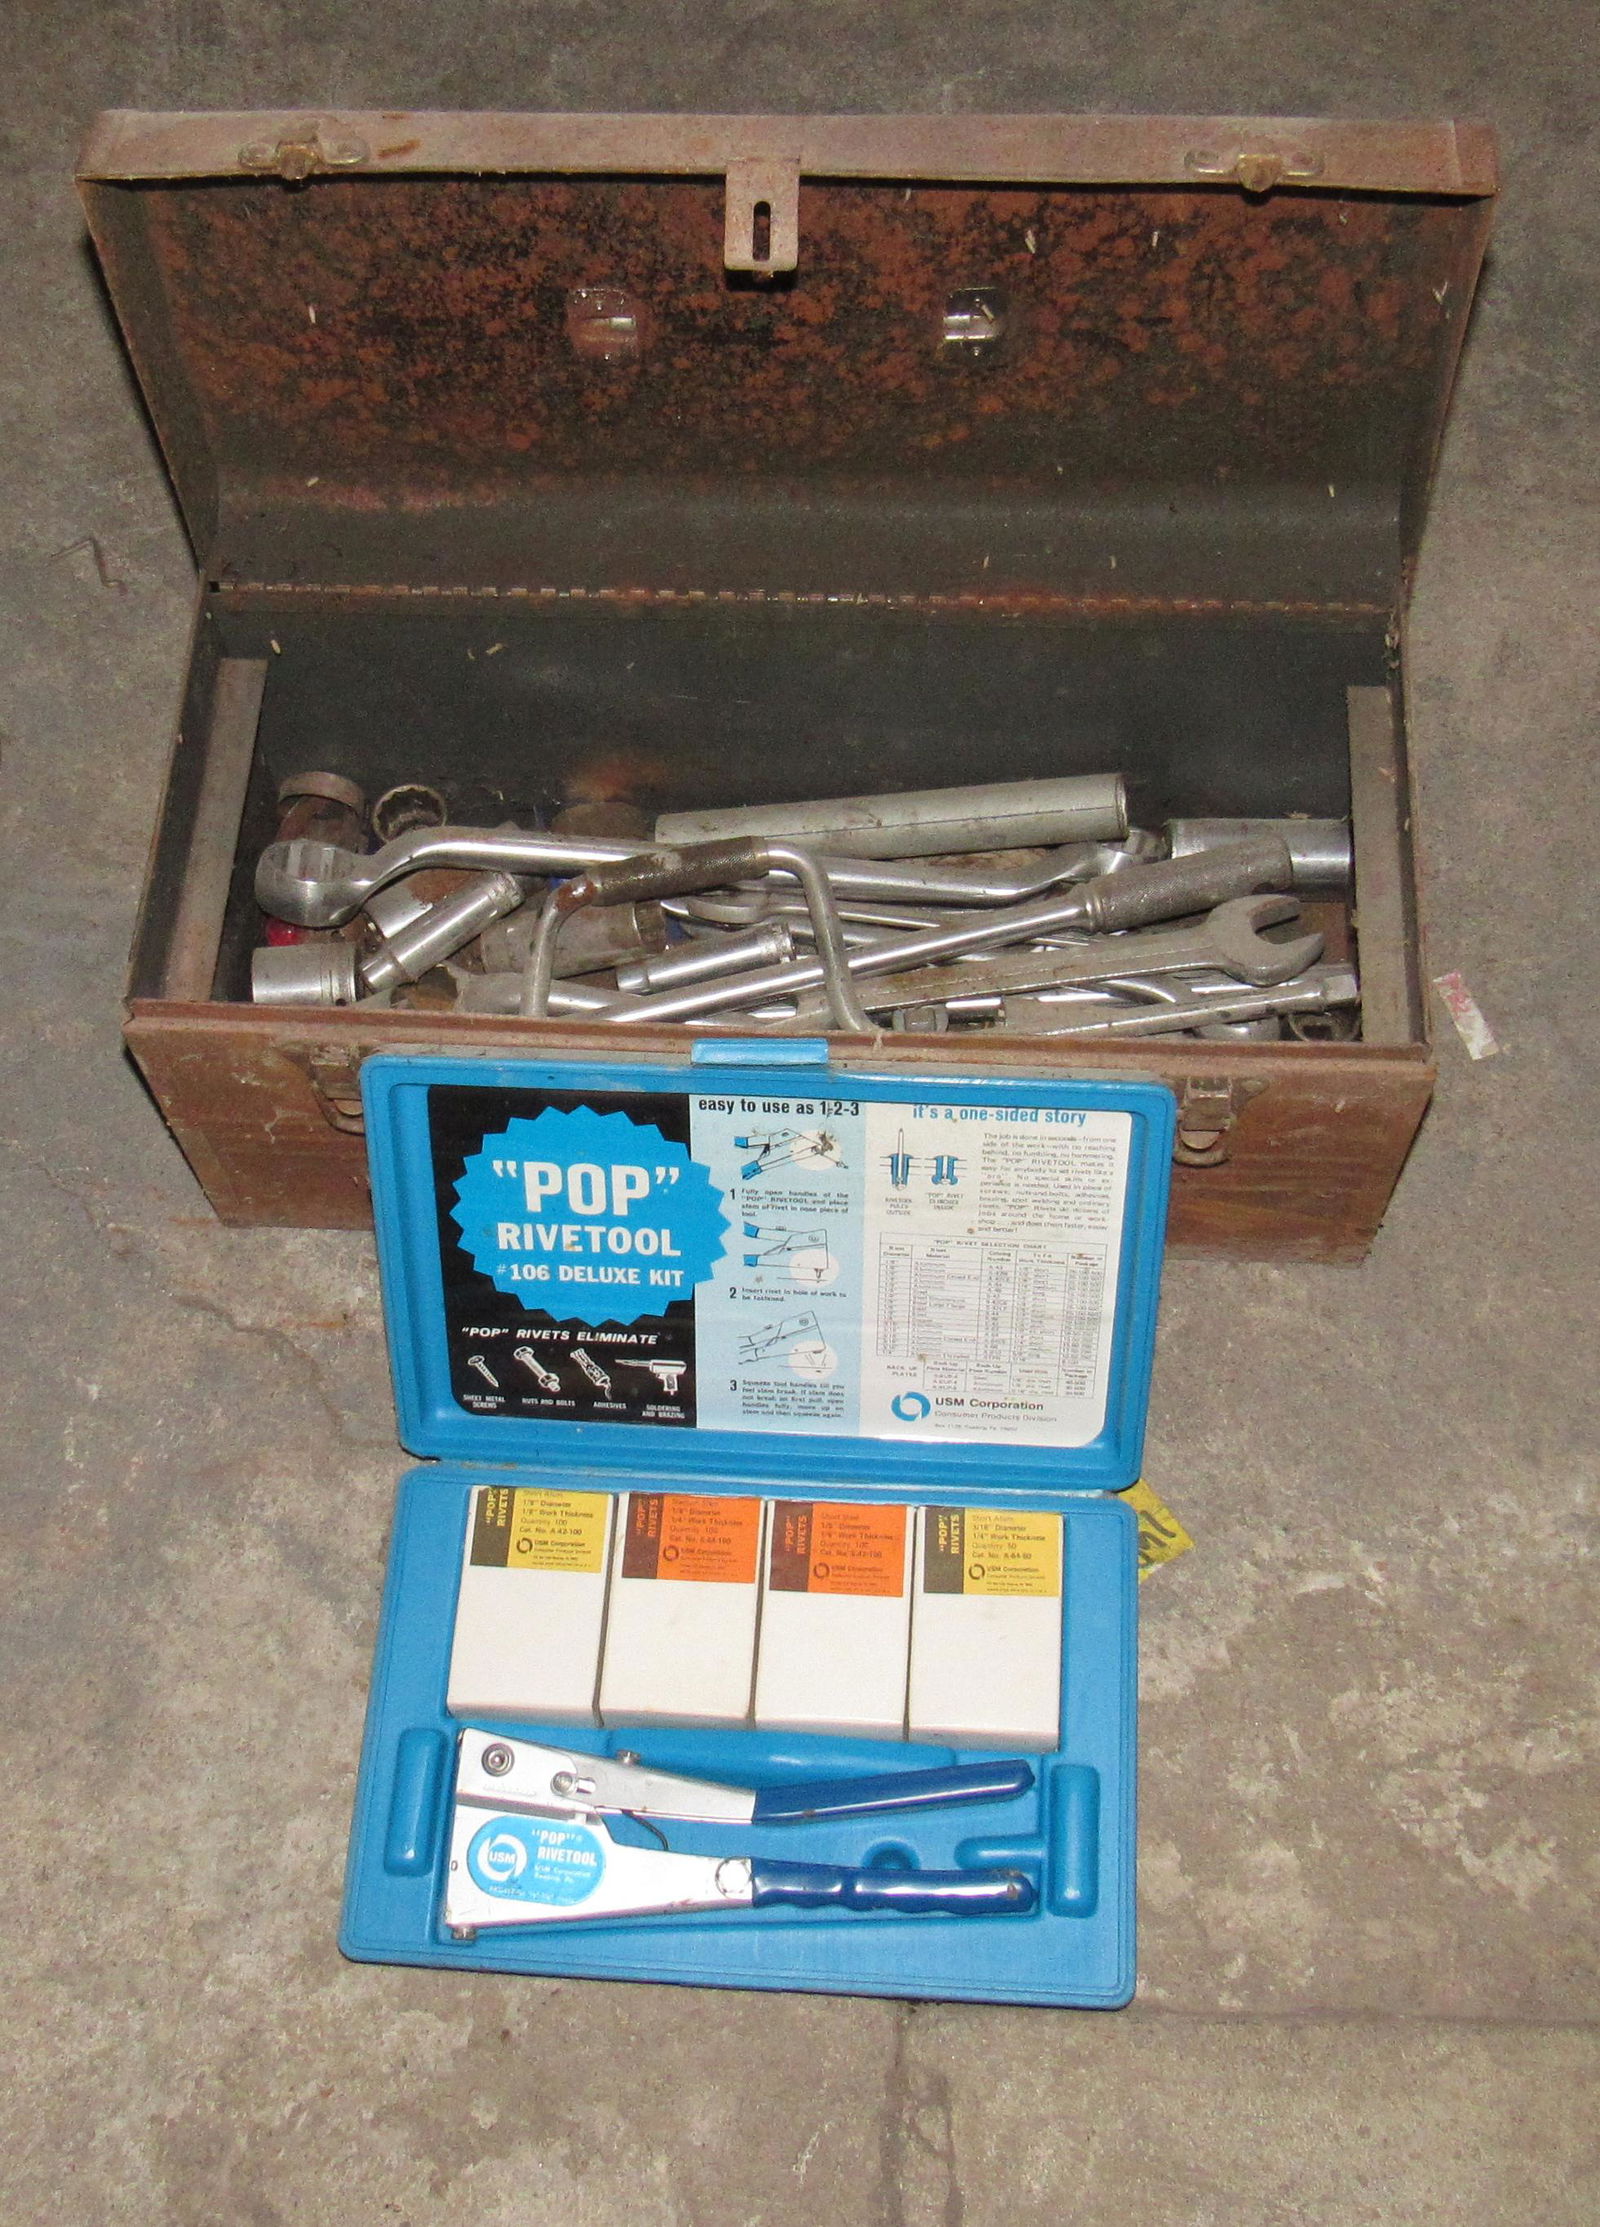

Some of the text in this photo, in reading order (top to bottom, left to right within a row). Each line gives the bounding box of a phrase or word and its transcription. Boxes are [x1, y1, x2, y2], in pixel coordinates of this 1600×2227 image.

[699, 1099, 734, 1114] easy
[741, 1099, 756, 1112] to
[762, 1102, 790, 1114] use
[796, 1103, 814, 1115] as
[913, 1105, 1087, 1126] it's a one-sided story
[492, 1160, 679, 1216] "POP"
[730, 1188, 735, 1200] 1
[497, 1222, 682, 1257] RIVETOOL
[497, 1264, 684, 1286] #106 DELUXE KIT
[730, 1287, 736, 1298] 2
[516, 1329, 570, 1340] RIVETS
[577, 1332, 658, 1344] ELIMINATE
[730, 1380, 737, 1391] 3
[935, 1397, 1044, 1410] USM Corporation
[1023, 1413, 1057, 1422] Division
[497, 1488, 508, 1526] RIVETS
[951, 1514, 959, 1554] RIVETS
[489, 1851, 516, 1864] USM
[537, 1846, 597, 1867] RIVETOOL
